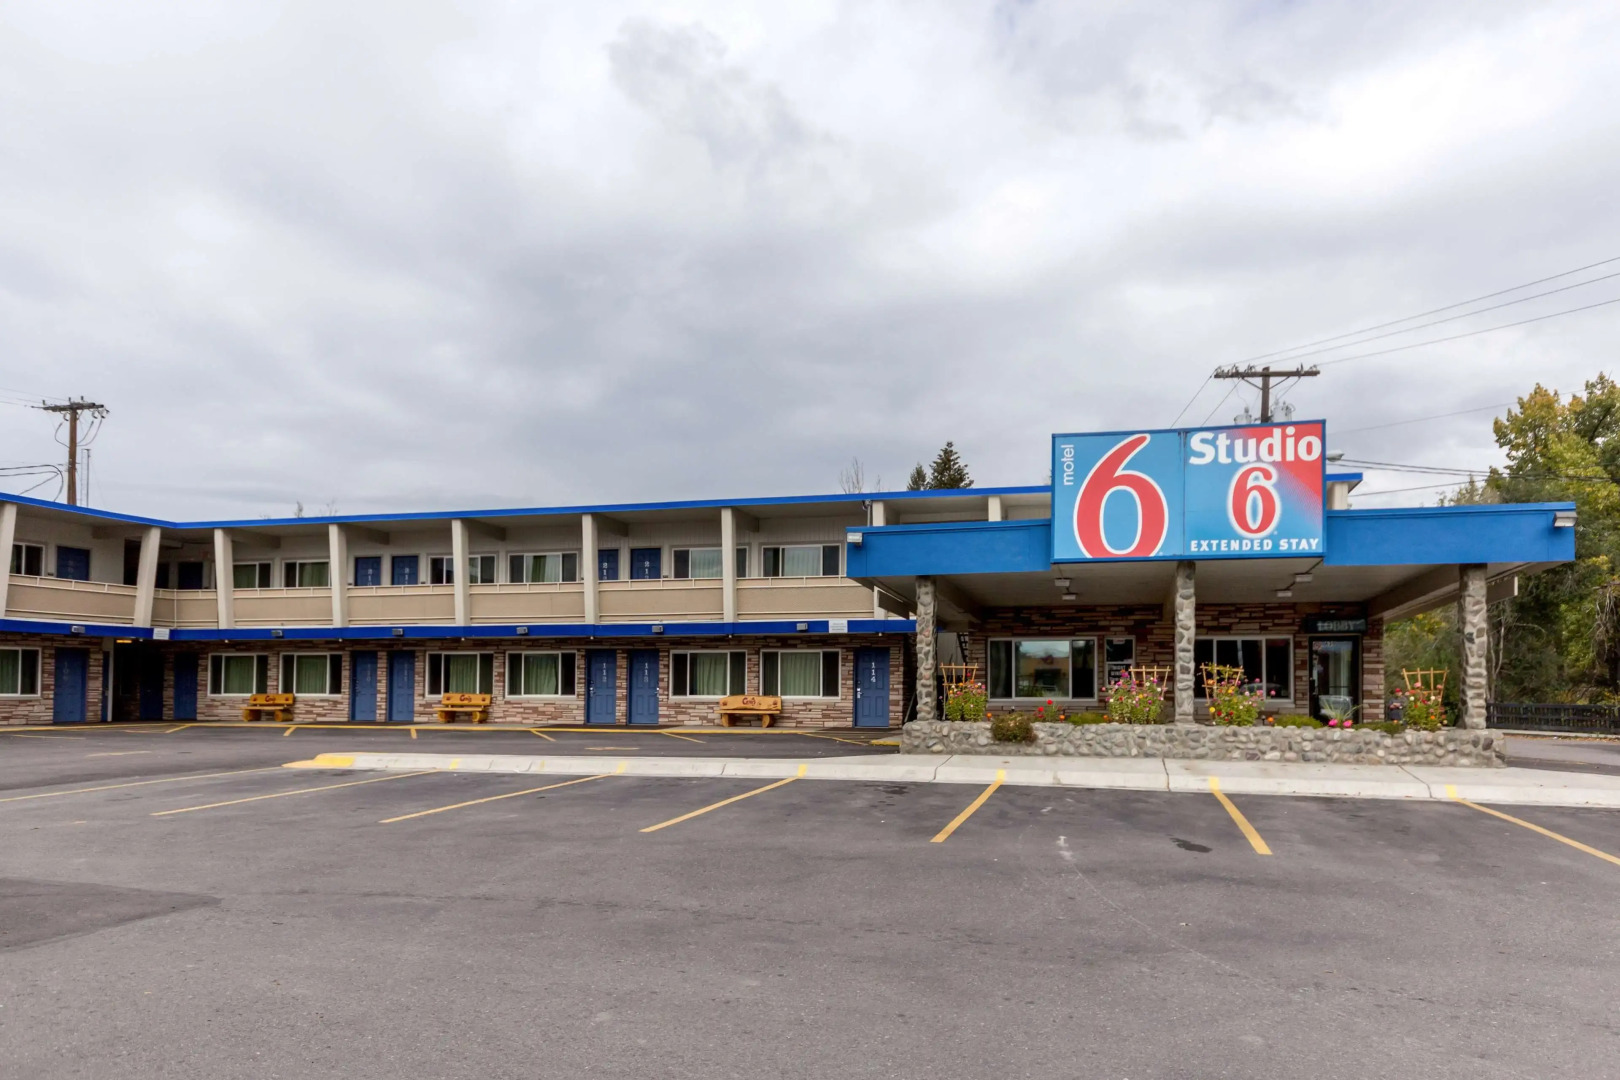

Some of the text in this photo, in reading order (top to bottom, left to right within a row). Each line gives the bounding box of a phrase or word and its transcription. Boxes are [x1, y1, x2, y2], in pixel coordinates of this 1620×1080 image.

[1061, 444, 1074, 485] motel
[1189, 426, 1322, 465] Studio
[1073, 433, 1169, 558] 6
[1229, 463, 1280, 538] 6
[1190, 538, 1319, 552] EXTENDED STAY
